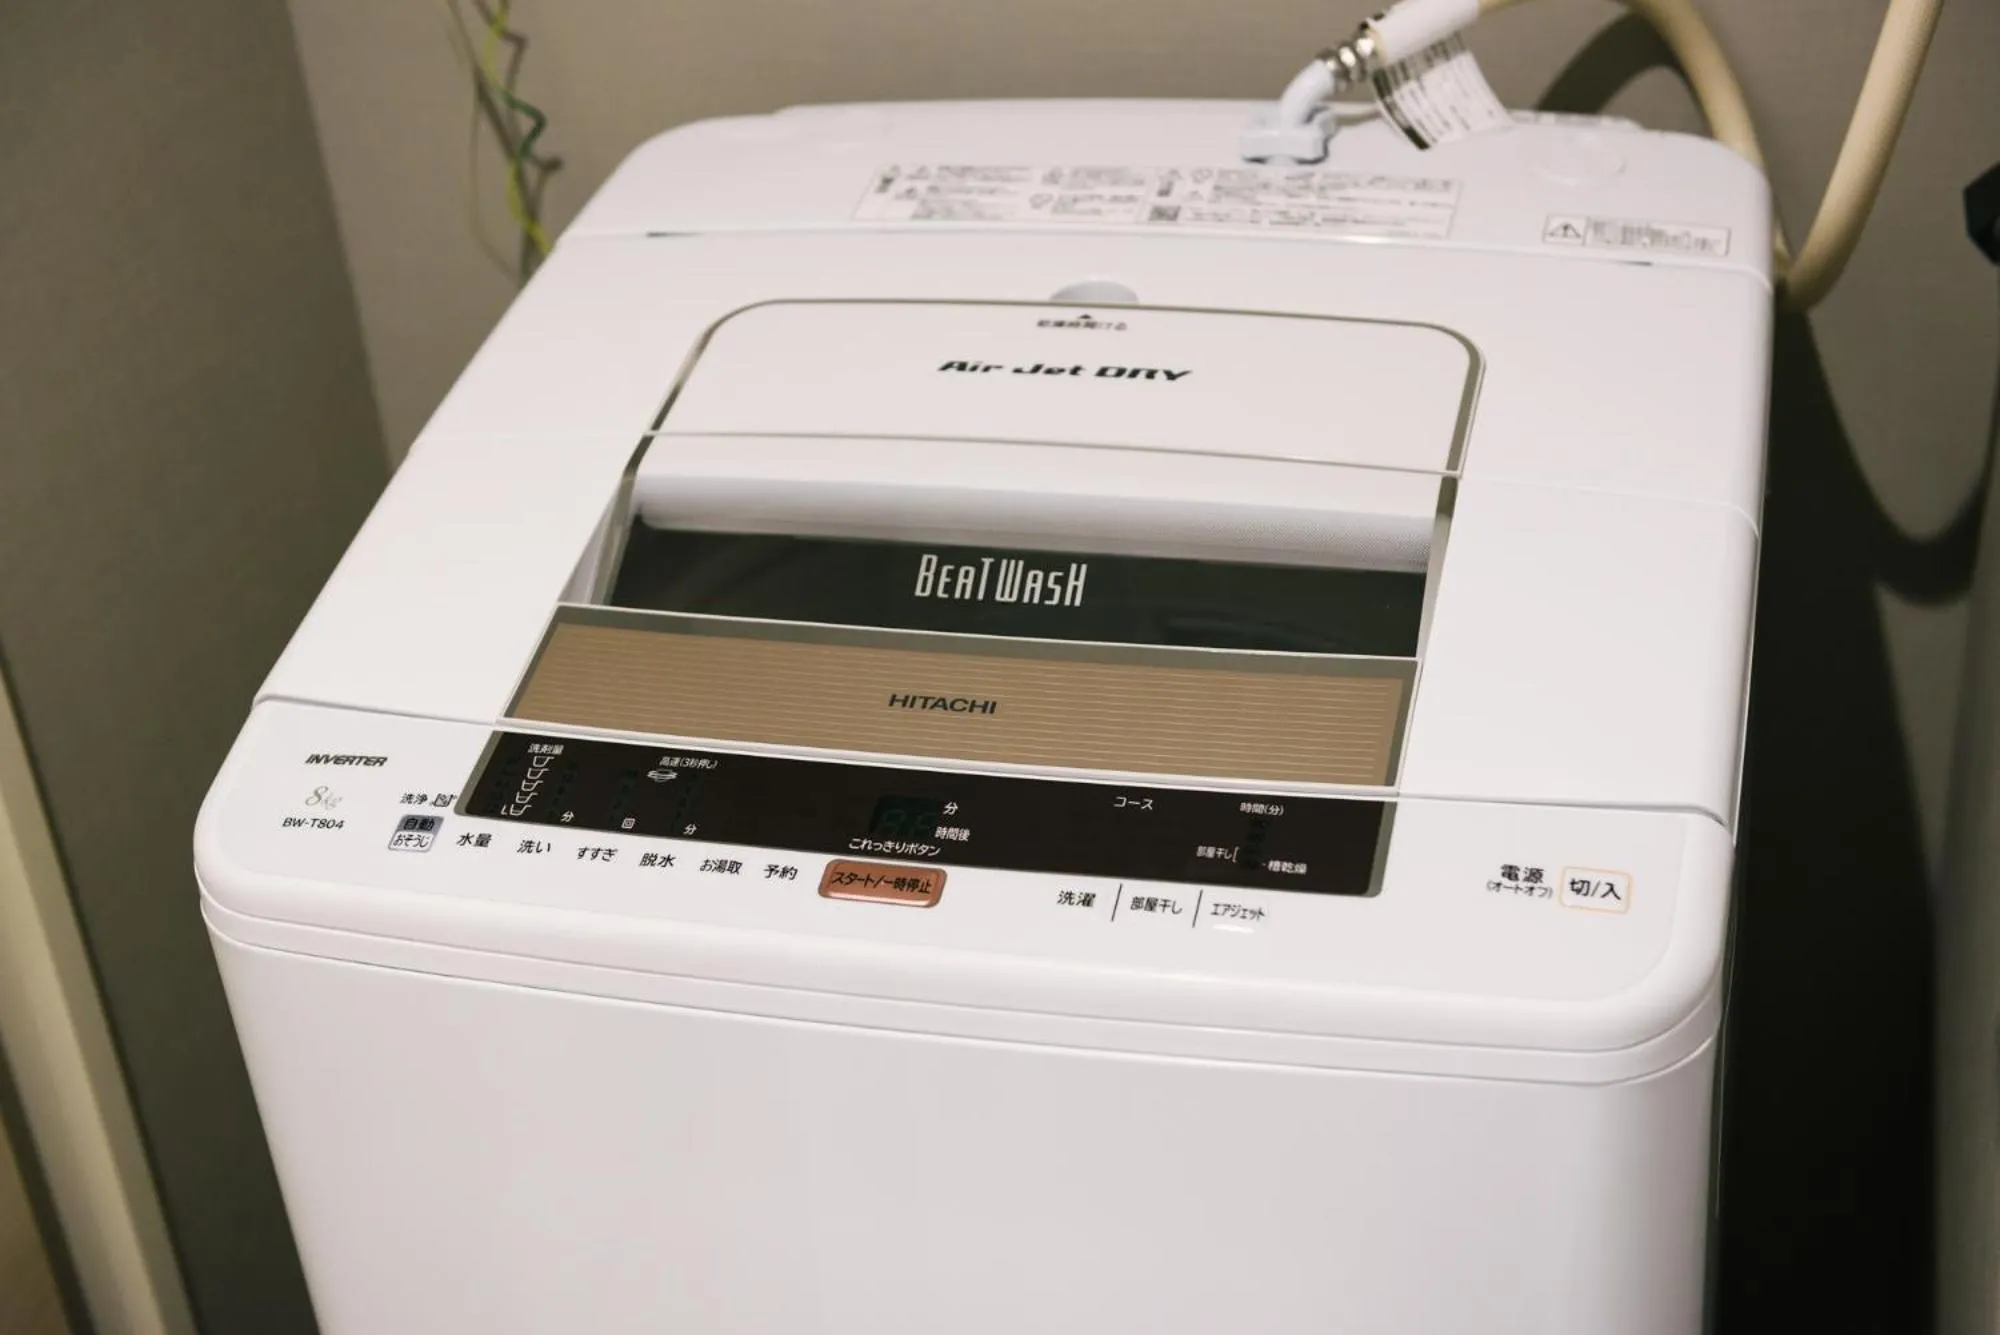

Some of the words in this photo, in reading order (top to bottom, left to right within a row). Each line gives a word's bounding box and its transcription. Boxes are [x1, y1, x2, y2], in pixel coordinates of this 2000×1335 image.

[937, 360, 1004, 373] Air
[1010, 363, 1086, 376] Jet
[1093, 366, 1194, 382] DRY
[888, 693, 998, 714] HITACHI
[304, 753, 388, 767] INVERTER
[400, 792, 429, 805] 洗浄
[1113, 796, 1154, 811] コース
[560, 810, 575, 823] 分
[943, 802, 959, 816] 分
[1239, 802, 1285, 817] 時間(分)
[281, 817, 346, 830] BW-T804
[402, 818, 436, 833] 自動
[683, 823, 698, 836] 分
[392, 832, 431, 848] おそうじ
[456, 832, 493, 849] 水量
[934, 826, 970, 842] 時間後
[516, 839, 552, 855] 洗い
[576, 847, 618, 863] すすぎ
[848, 838, 941, 857] これっきりボタン
[639, 853, 676, 869] 脱水
[699, 859, 743, 876] お湯取
[763, 863, 798, 881] 予約
[1499, 864, 1545, 883] 電源
[831, 871, 933, 895] スタート/一時停止
[1486, 881, 1554, 899] (オートオフ)
[1569, 878, 1622, 901] 切/入
[1056, 890, 1097, 908] 洗濯
[1129, 896, 1183, 915] 部屋干し
[1209, 903, 1266, 922] エアジェット
